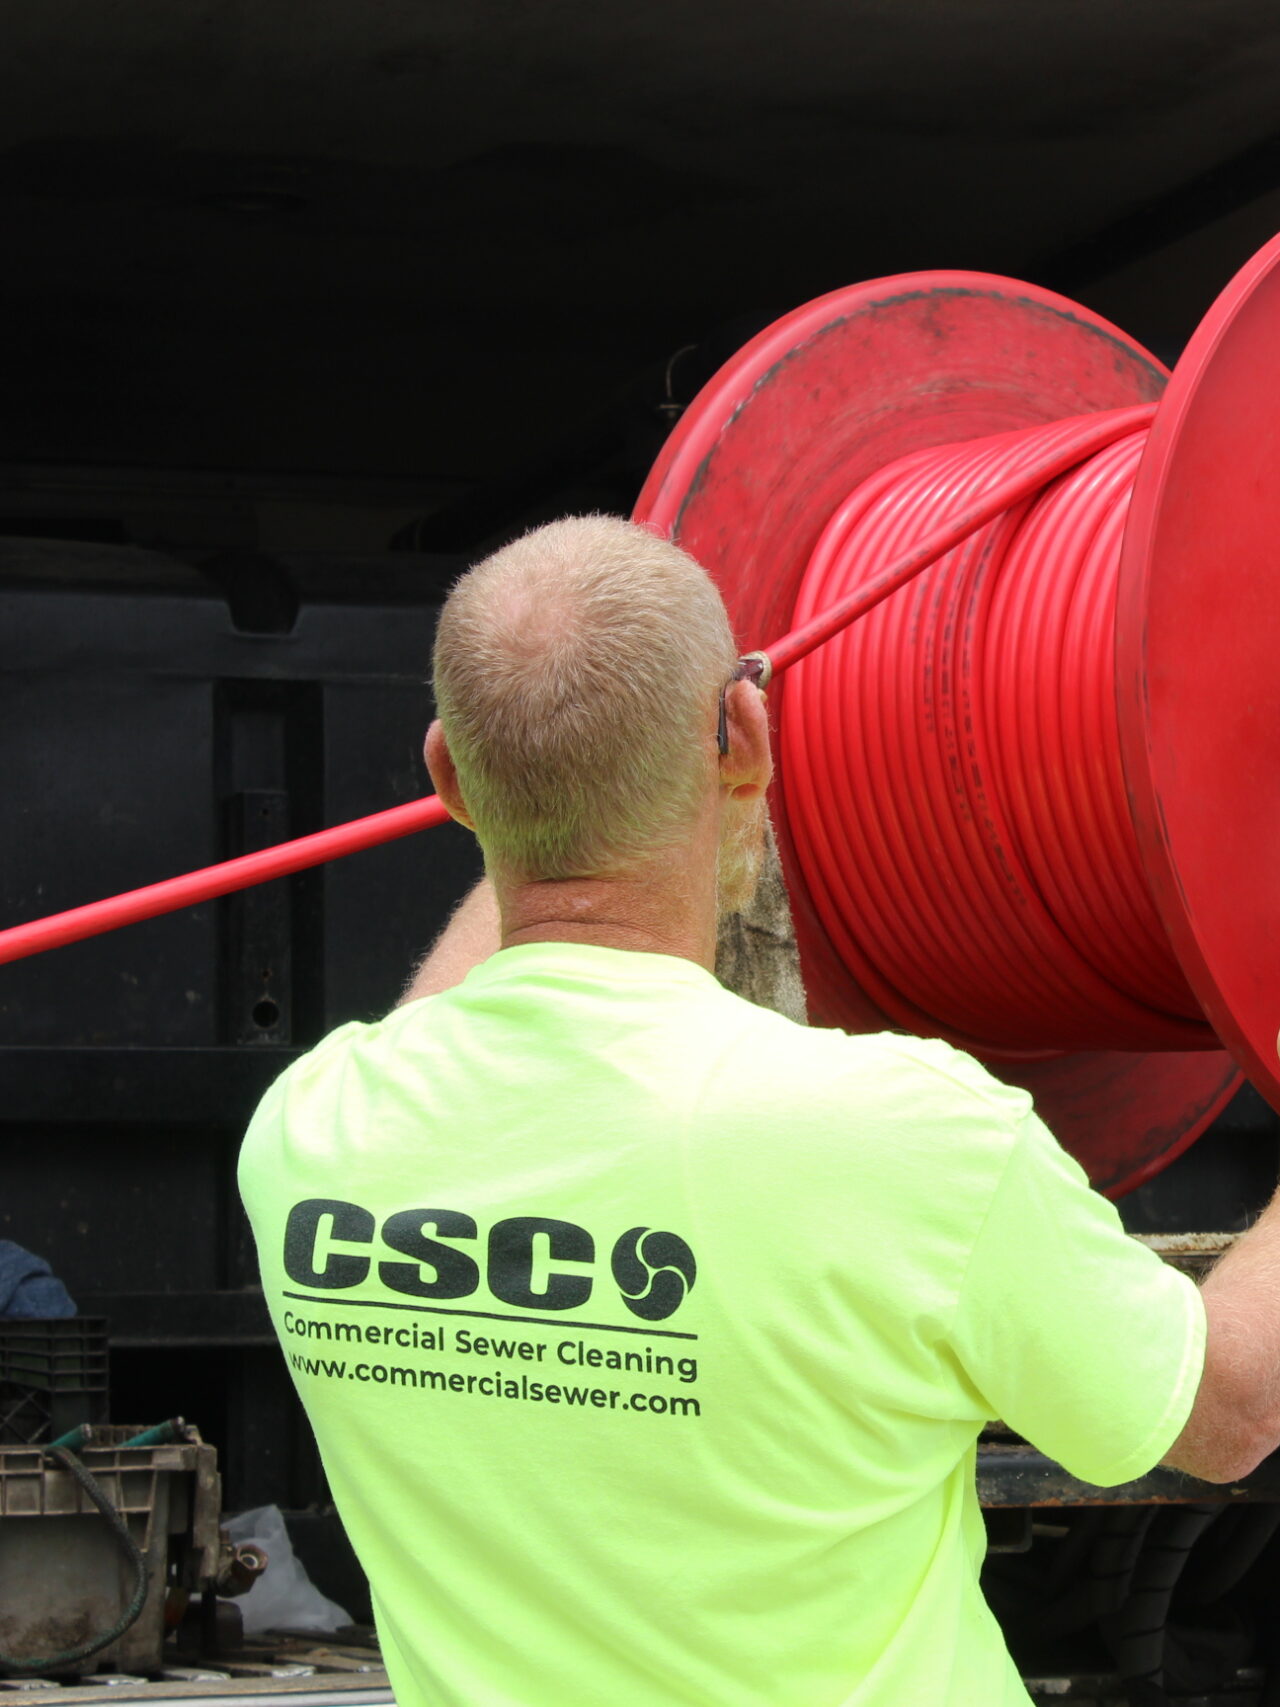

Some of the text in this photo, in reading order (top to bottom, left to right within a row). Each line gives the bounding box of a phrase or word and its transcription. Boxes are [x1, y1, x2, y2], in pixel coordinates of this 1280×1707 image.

[283, 1199, 595, 1311] CSC
[284, 1311, 697, 1383] Commercial Sewer Cleaning
[288, 1351, 701, 1416] www.commercialsewer.com
